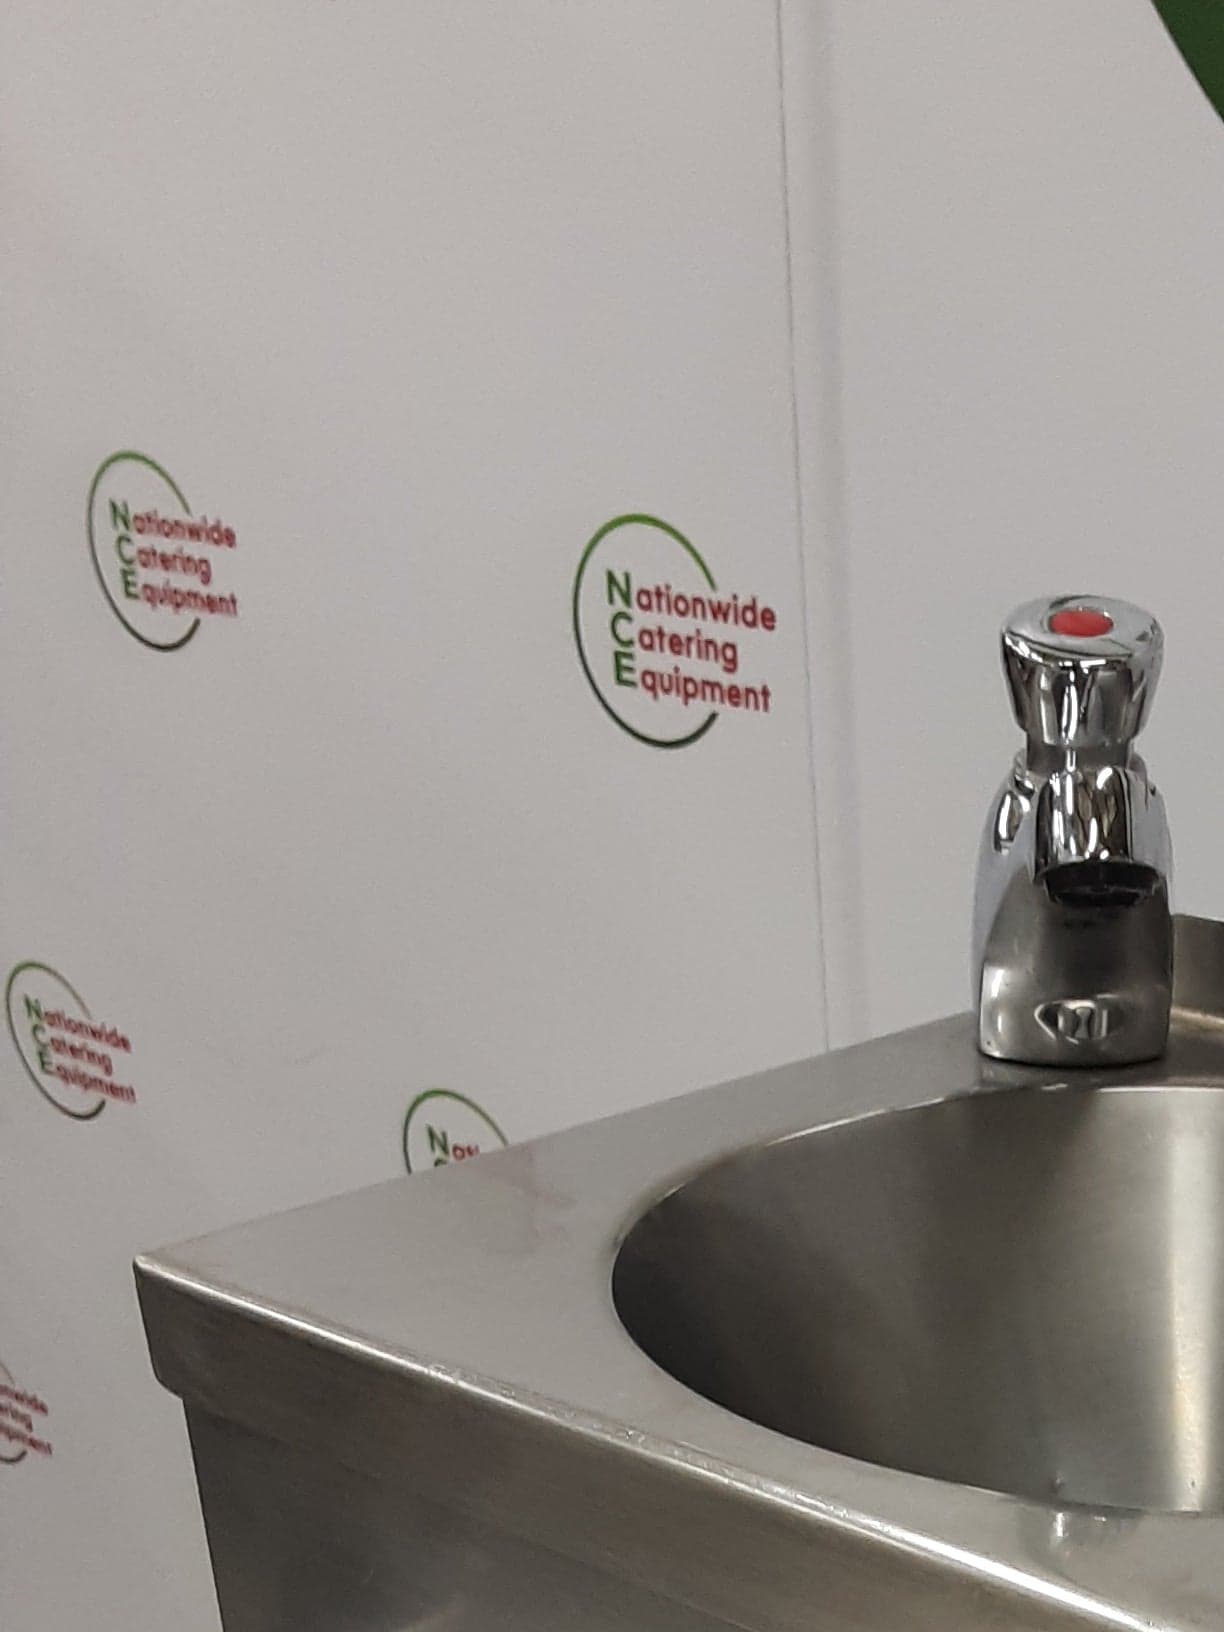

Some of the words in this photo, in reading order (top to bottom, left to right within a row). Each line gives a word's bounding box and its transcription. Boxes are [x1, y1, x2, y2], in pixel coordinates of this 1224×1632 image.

[108, 498, 236, 549] Nationwide
[116, 534, 212, 586] Catering
[120, 567, 237, 616] Equipment
[605, 568, 777, 632] Nationwide
[611, 611, 739, 674] Catering
[614, 650, 771, 712] Equipment
